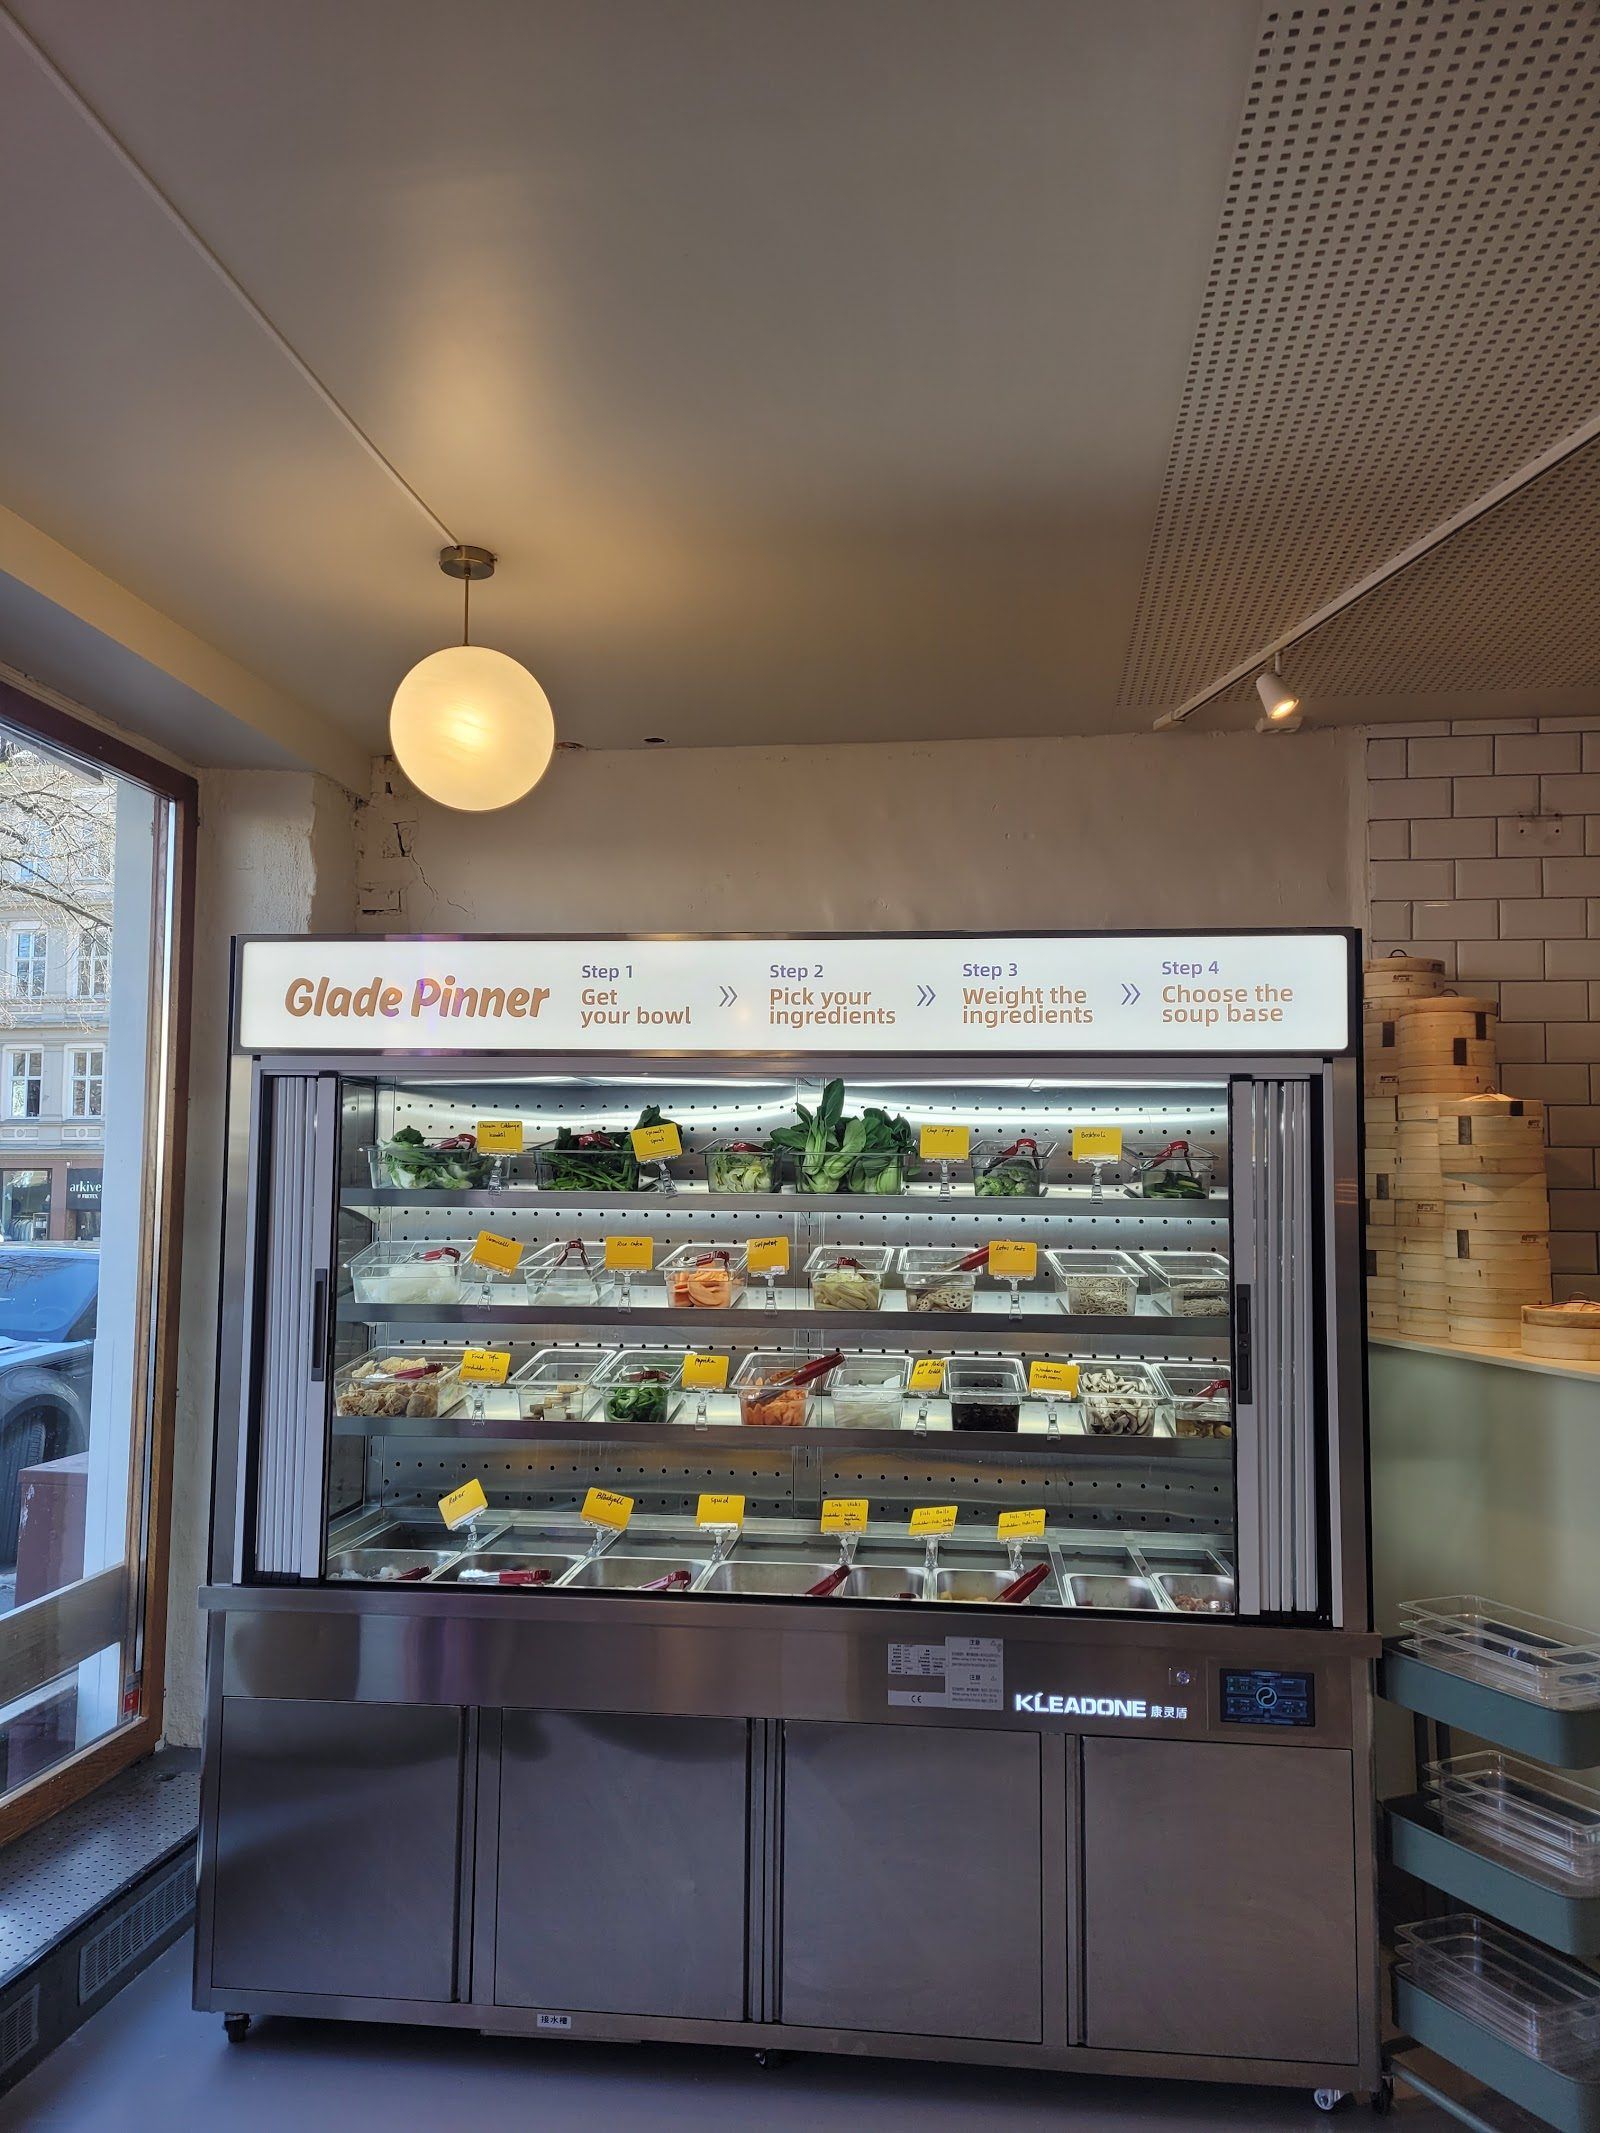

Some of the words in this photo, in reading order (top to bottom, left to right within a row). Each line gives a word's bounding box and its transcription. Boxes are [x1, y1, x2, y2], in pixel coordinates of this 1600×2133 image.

[581, 965, 619, 981] Step
[625, 965, 633, 979] 1
[770, 964, 808, 980] Step
[813, 964, 824, 978] 2
[963, 963, 1002, 979] Step
[1008, 963, 1018, 977] 3
[1161, 961, 1201, 978] Step
[1208, 961, 1220, 975] 4
[284, 976, 401, 1018] Glade
[410, 976, 551, 1018] Pinner
[581, 988, 618, 1006] Get
[770, 987, 814, 1005] Pick
[820, 991, 872, 1010] your
[963, 986, 1044, 1007] Weight
[1050, 986, 1087, 1004] the
[1162, 984, 1247, 1003] Choose
[1256, 983, 1293, 1002] the
[581, 1010, 631, 1029] your
[636, 1006, 692, 1025] bowl
[769, 1006, 896, 1028] ingredients
[963, 1005, 1094, 1028] ingredients
[1162, 1007, 1220, 1027] soup
[1226, 1003, 1284, 1022] base
[70, 1180, 102, 1192] arkive
[1015, 1692, 1147, 1717] KLEADONE
